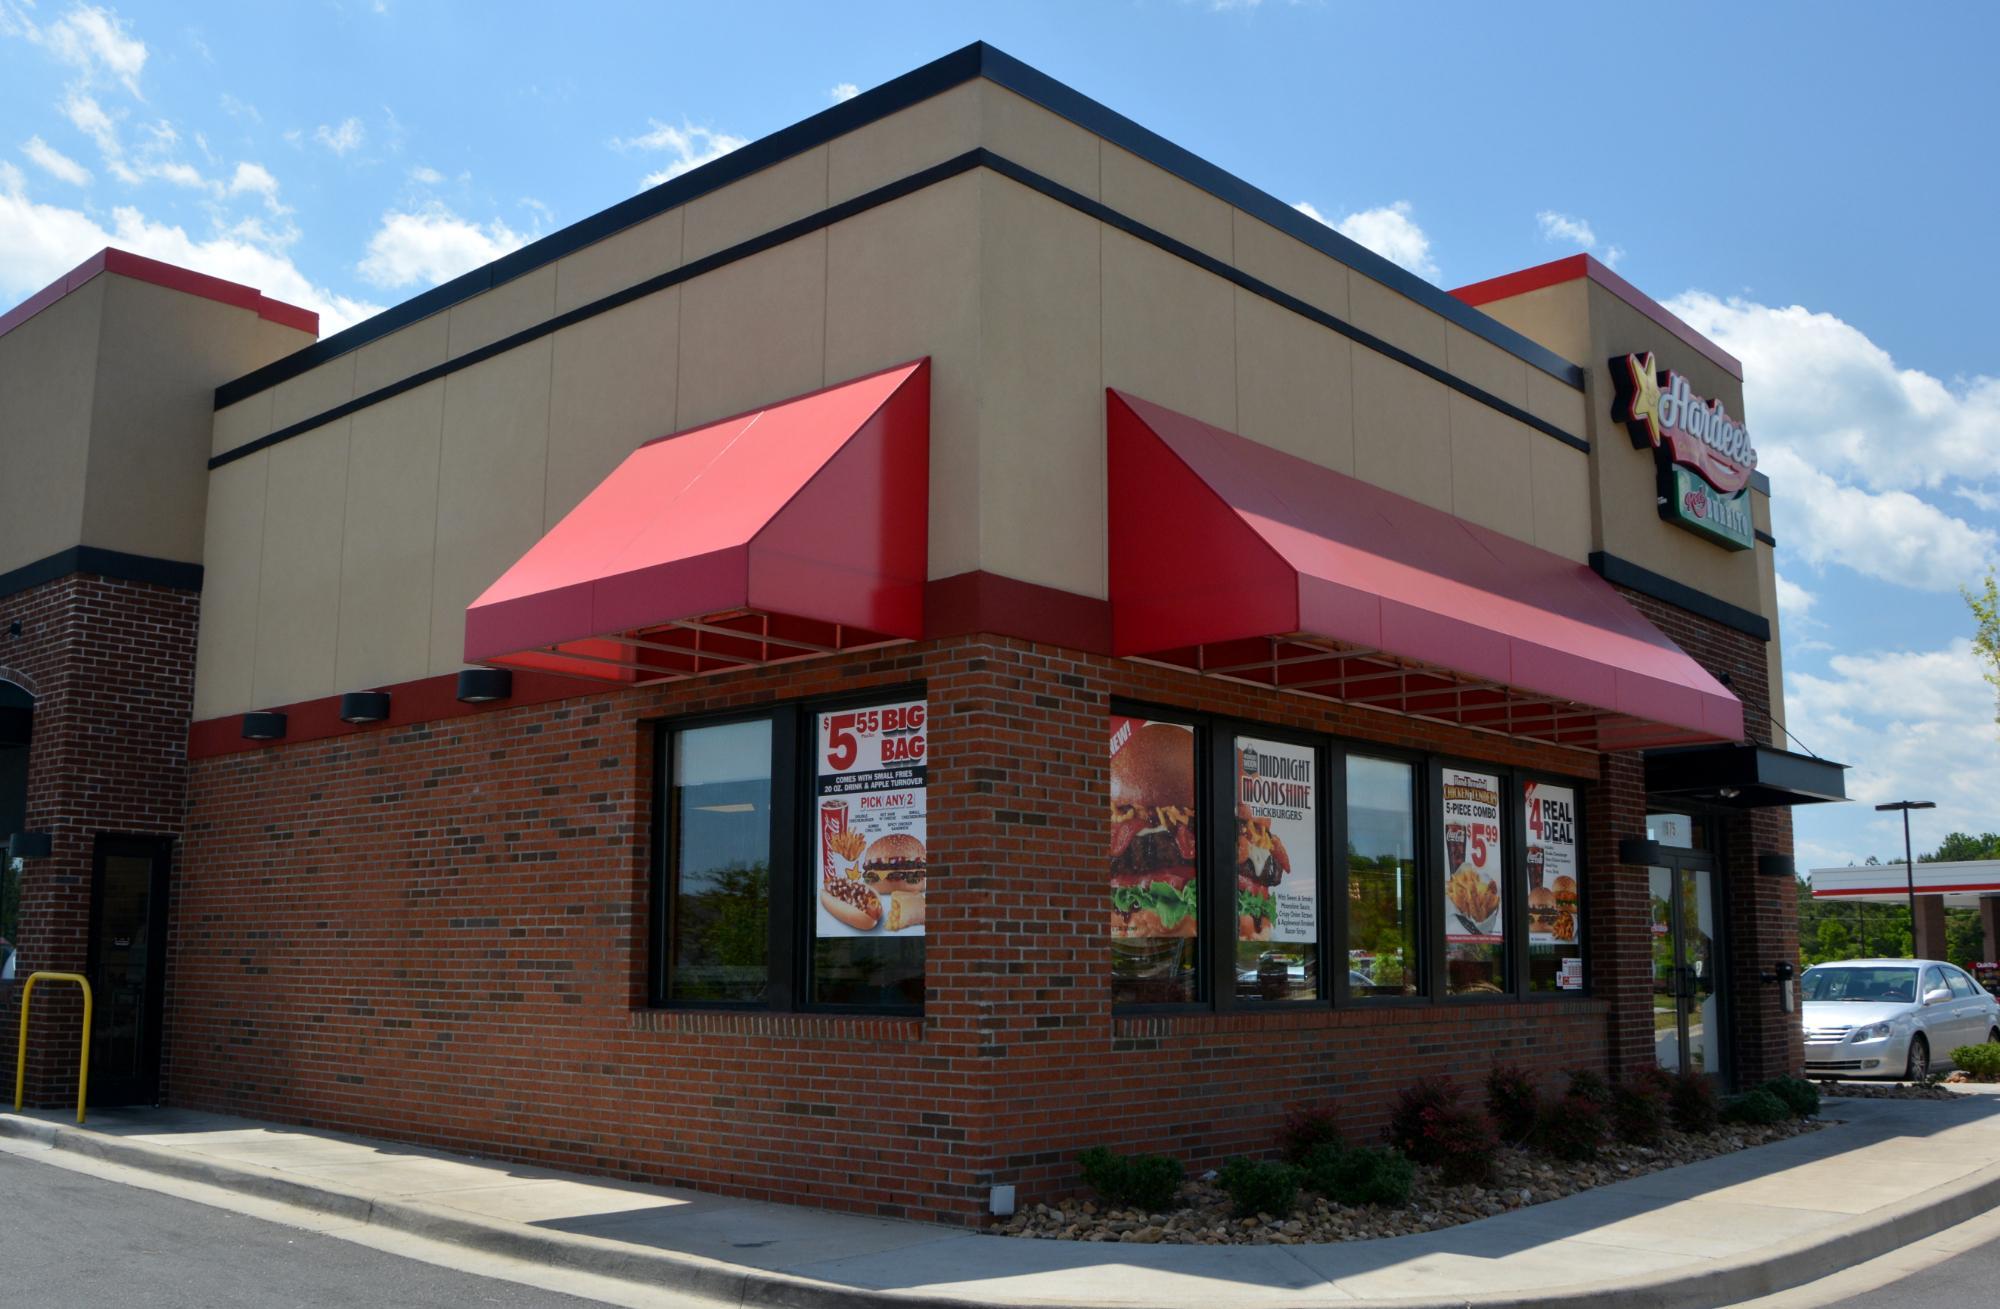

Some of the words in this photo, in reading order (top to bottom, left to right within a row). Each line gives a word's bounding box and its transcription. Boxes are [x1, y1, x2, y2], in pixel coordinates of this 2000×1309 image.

[1659, 373, 1752, 468] Hardee's
[881, 705, 925, 732] BIG
[881, 735, 925, 761] BAG
[836, 776, 857, 784] COMES
[858, 774, 873, 782] WITH
[874, 772, 893, 780] SMALL
[895, 770, 913, 778] FRIES
[1259, 753, 1311, 782] MIDNIGHT
[824, 785, 832, 793] 20
[844, 782, 863, 791] DRINK
[871, 780, 889, 788] APPLE
[891, 777, 923, 787] TURNOVER
[1242, 777, 1311, 809] MOONSHINE
[861, 795, 882, 808] PICK
[885, 794, 905, 806] ANY
[907, 793, 913, 805] 2
[1446, 803, 1472, 816] 5-PIECE
[1473, 806, 1497, 819] COMBO
[1543, 800, 1573, 823] REAL
[1252, 805, 1303, 820] THICKBURGERS
[1544, 821, 1574, 844] DEAL
